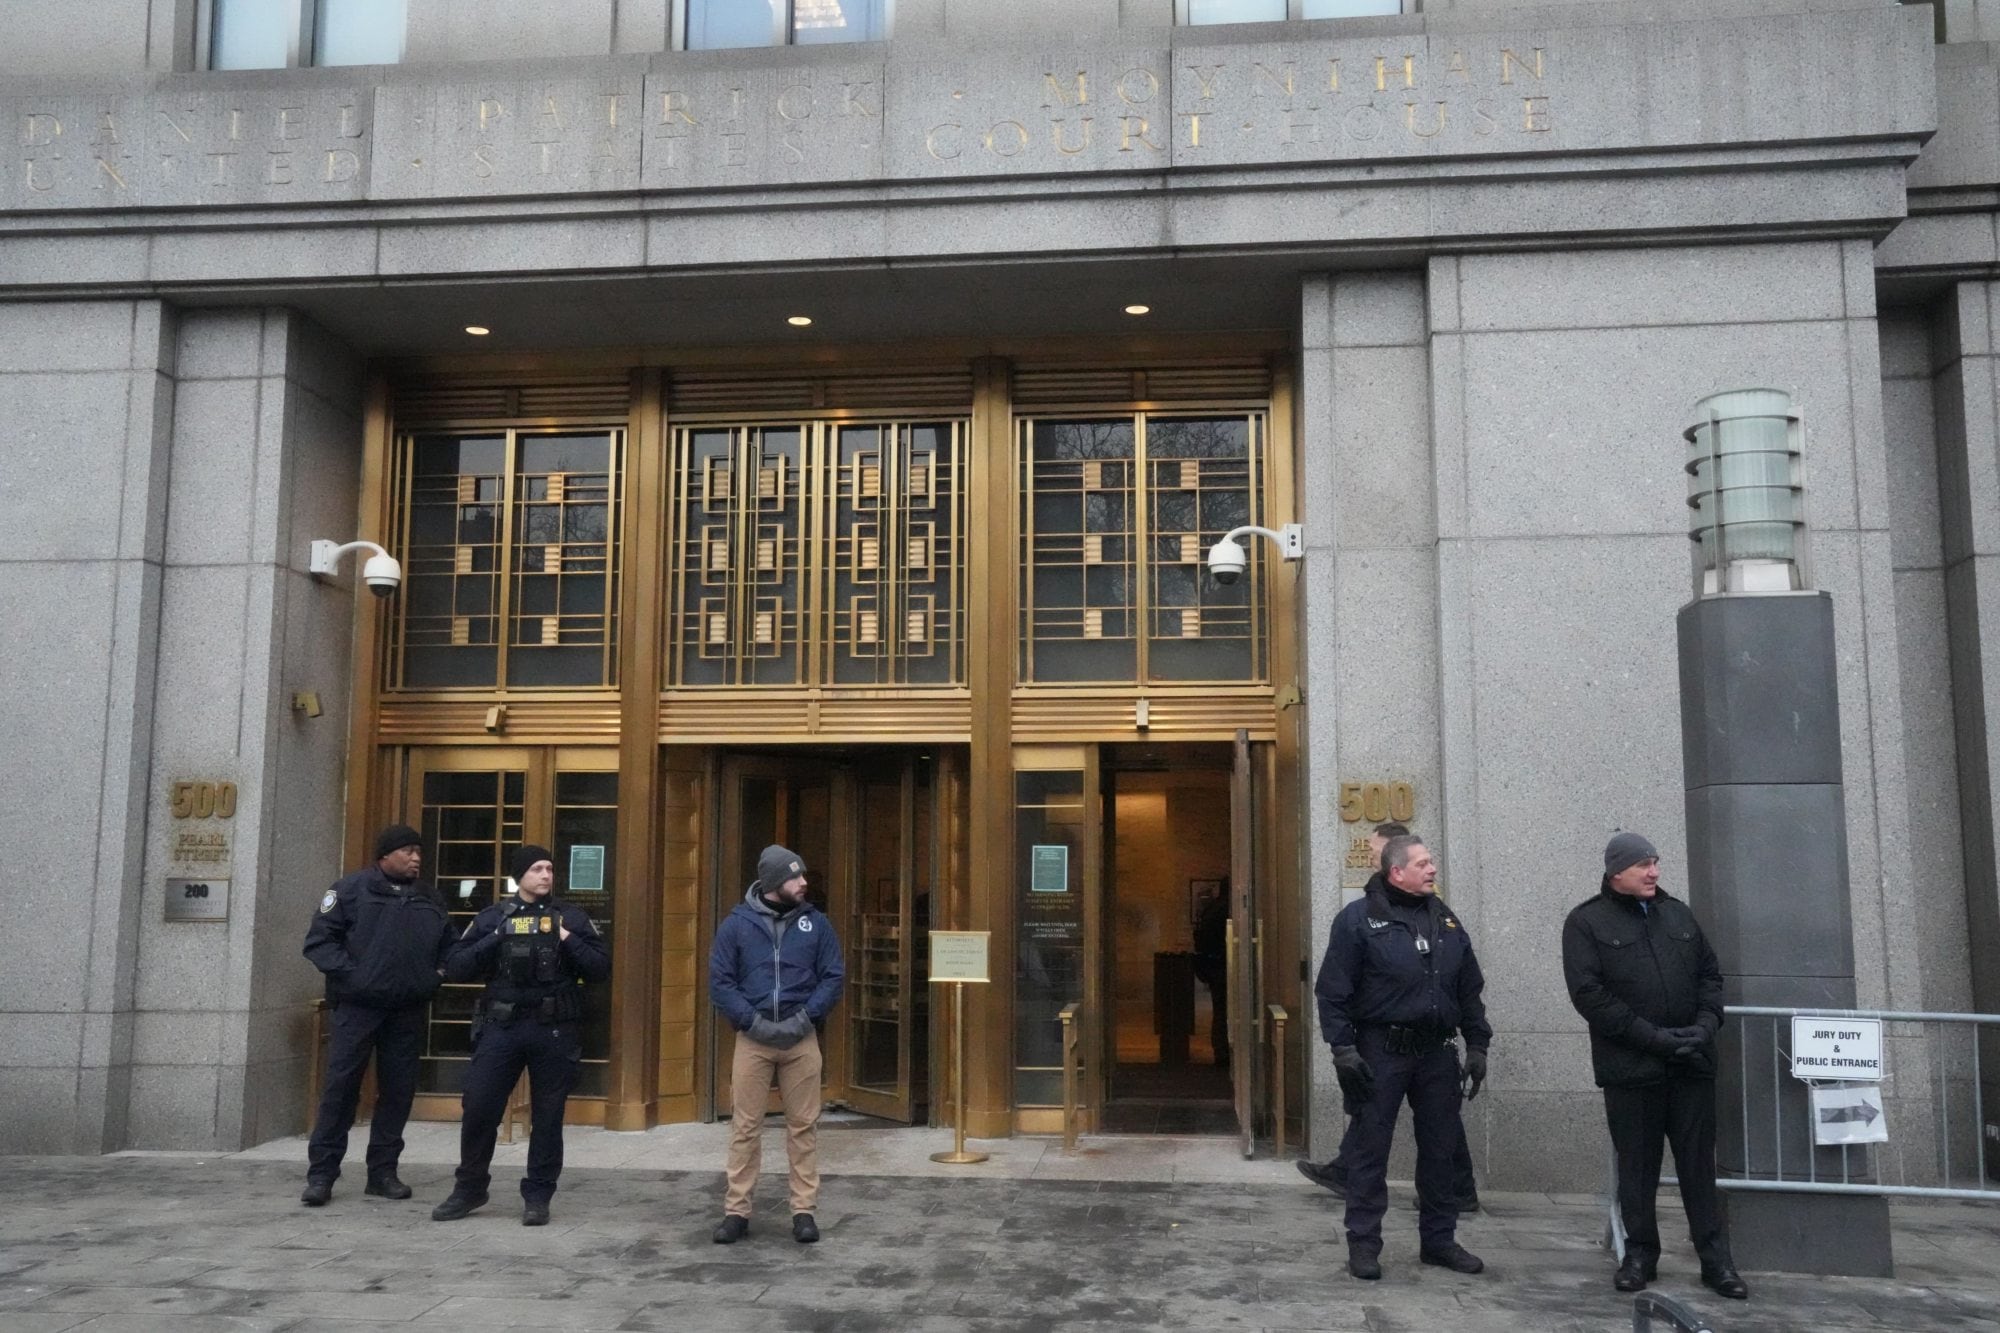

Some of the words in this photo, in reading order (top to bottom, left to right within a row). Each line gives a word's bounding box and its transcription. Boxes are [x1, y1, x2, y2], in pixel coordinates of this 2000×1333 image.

[26, 105, 364, 145] DANIEL
[479, 83, 876, 131] PATRICK
[1041, 48, 1544, 108] MOYNIHAN
[26, 149, 359, 191] UNITED
[473, 134, 806, 178] STATES
[926, 112, 1212, 160] COURT
[1281, 97, 1552, 145] HOUSE
[171, 781, 238, 819] 500
[1340, 783, 1414, 822] 500
[184, 884, 209, 898] 200
[1812, 1030, 1836, 1039] JURY
[1838, 1031, 1862, 1040] DUTY
[1833, 1044, 1841, 1053] &
[1796, 1056, 1829, 1066] PUBLIC
[1831, 1058, 1879, 1068] ENTRANCE
